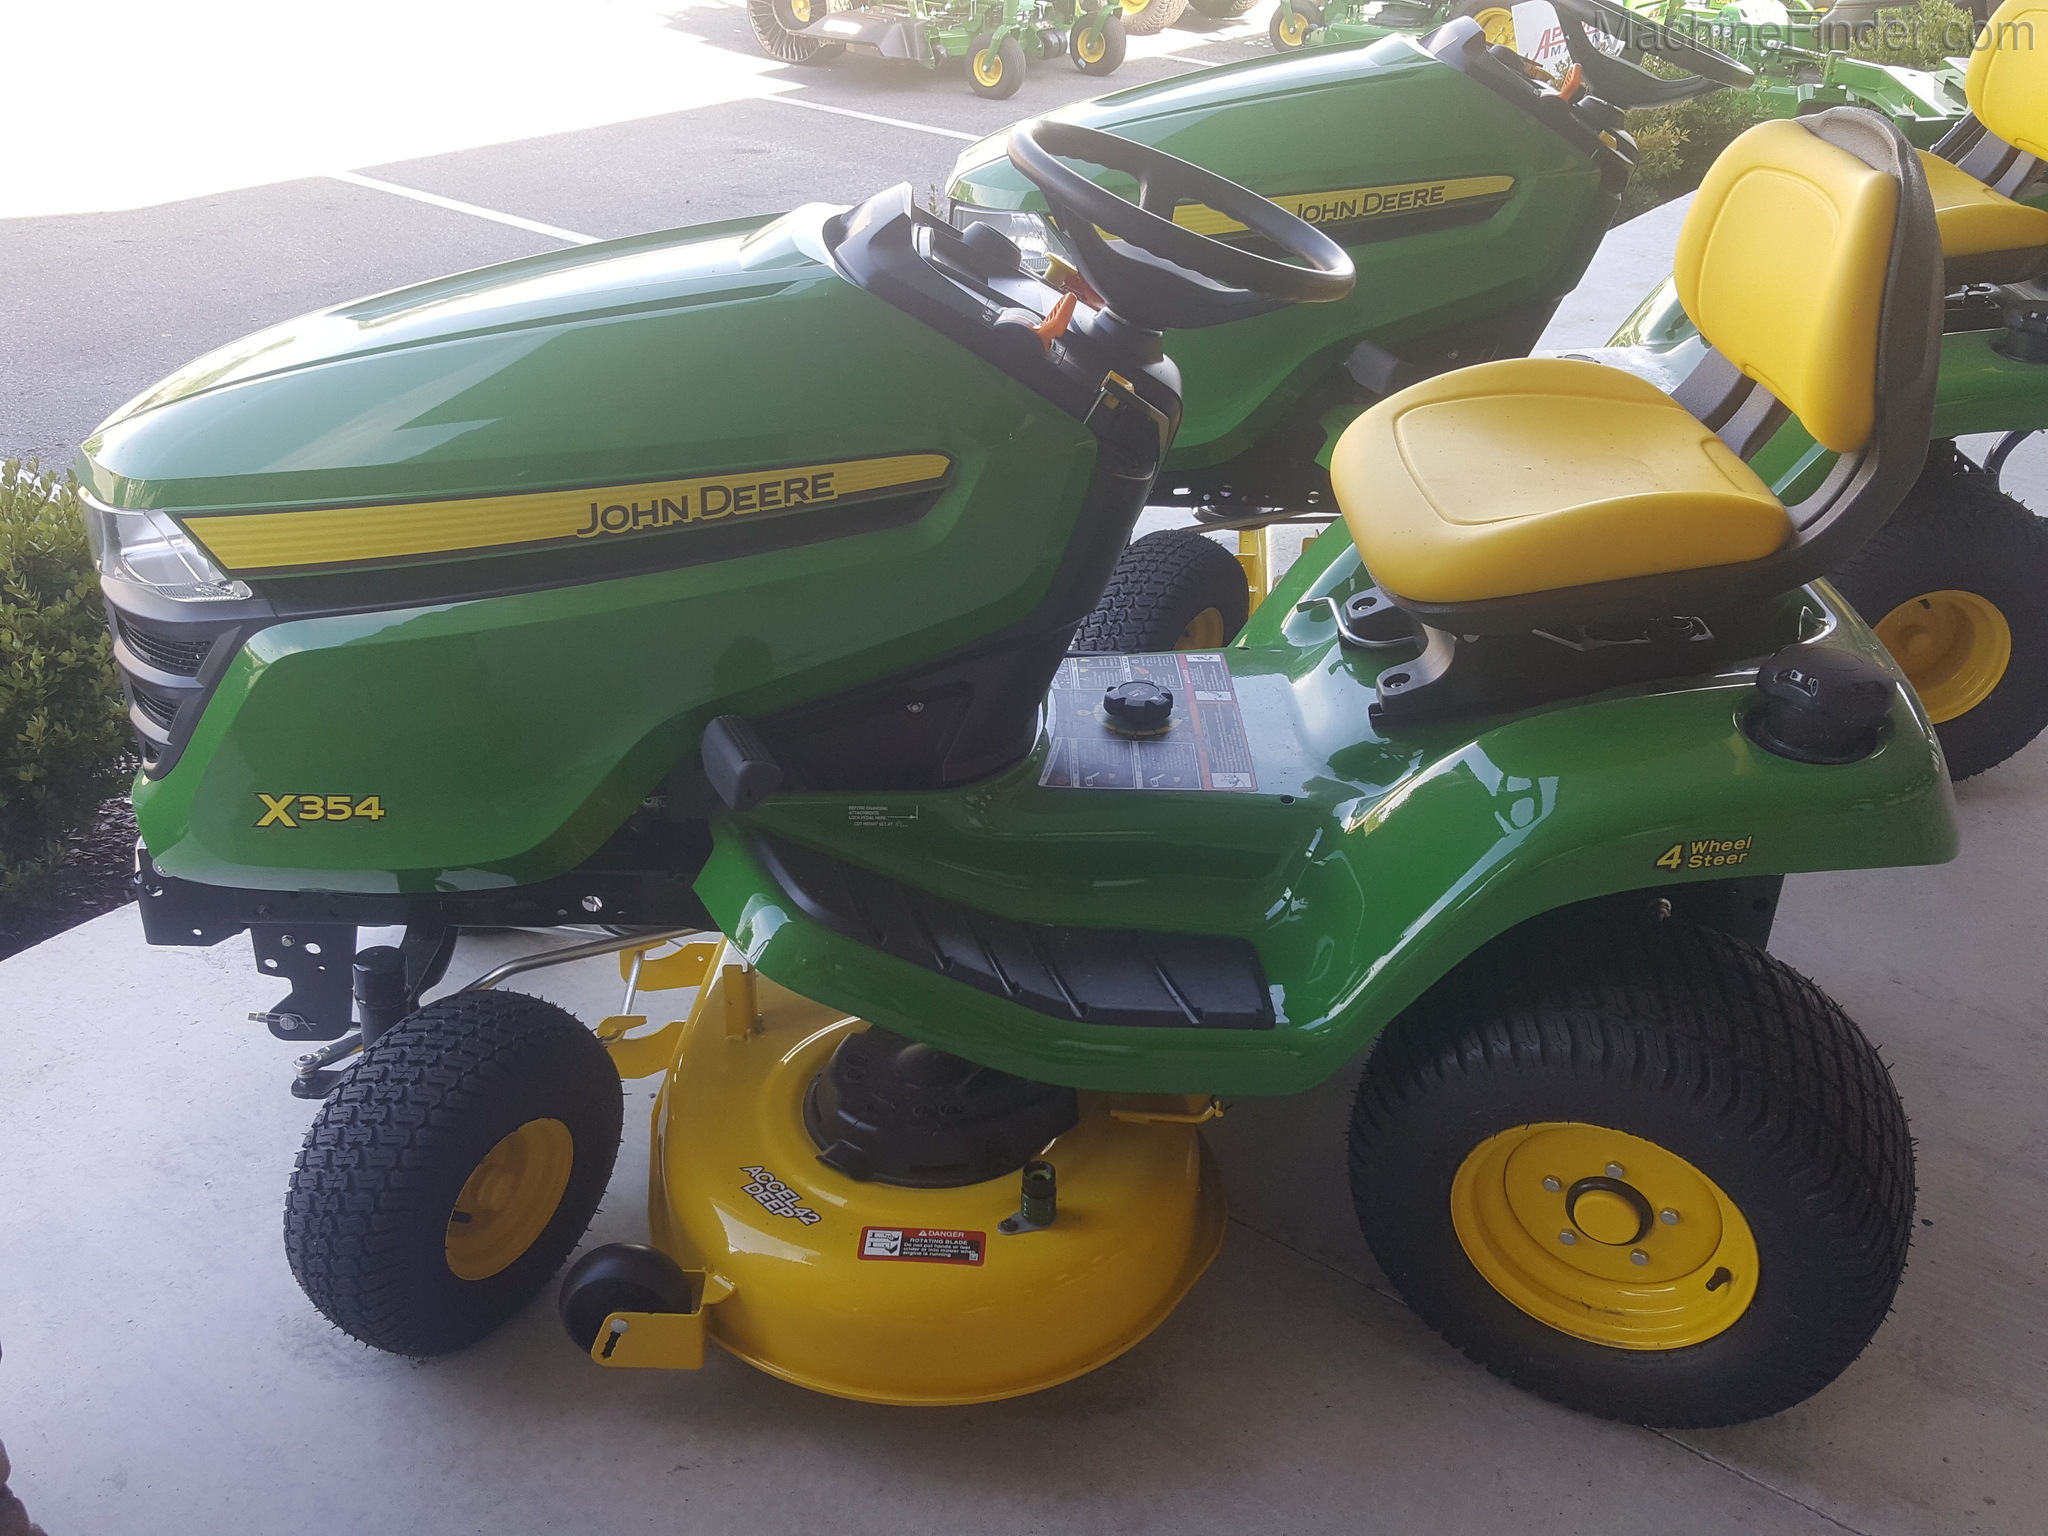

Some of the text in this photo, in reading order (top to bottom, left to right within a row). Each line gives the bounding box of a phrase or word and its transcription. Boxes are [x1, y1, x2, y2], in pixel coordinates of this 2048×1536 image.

[1297, 185, 1447, 222] JOHN DEERE
[576, 471, 837, 537] JOHN DEERE
[251, 791, 386, 829] X354
[1656, 835, 1753, 870] 4 Wheel
[1687, 852, 1749, 869] Steer
[740, 1165, 822, 1226] ACCEL 42
[740, 1181, 796, 1218] DEEP
[928, 1230, 964, 1238] DANGER
